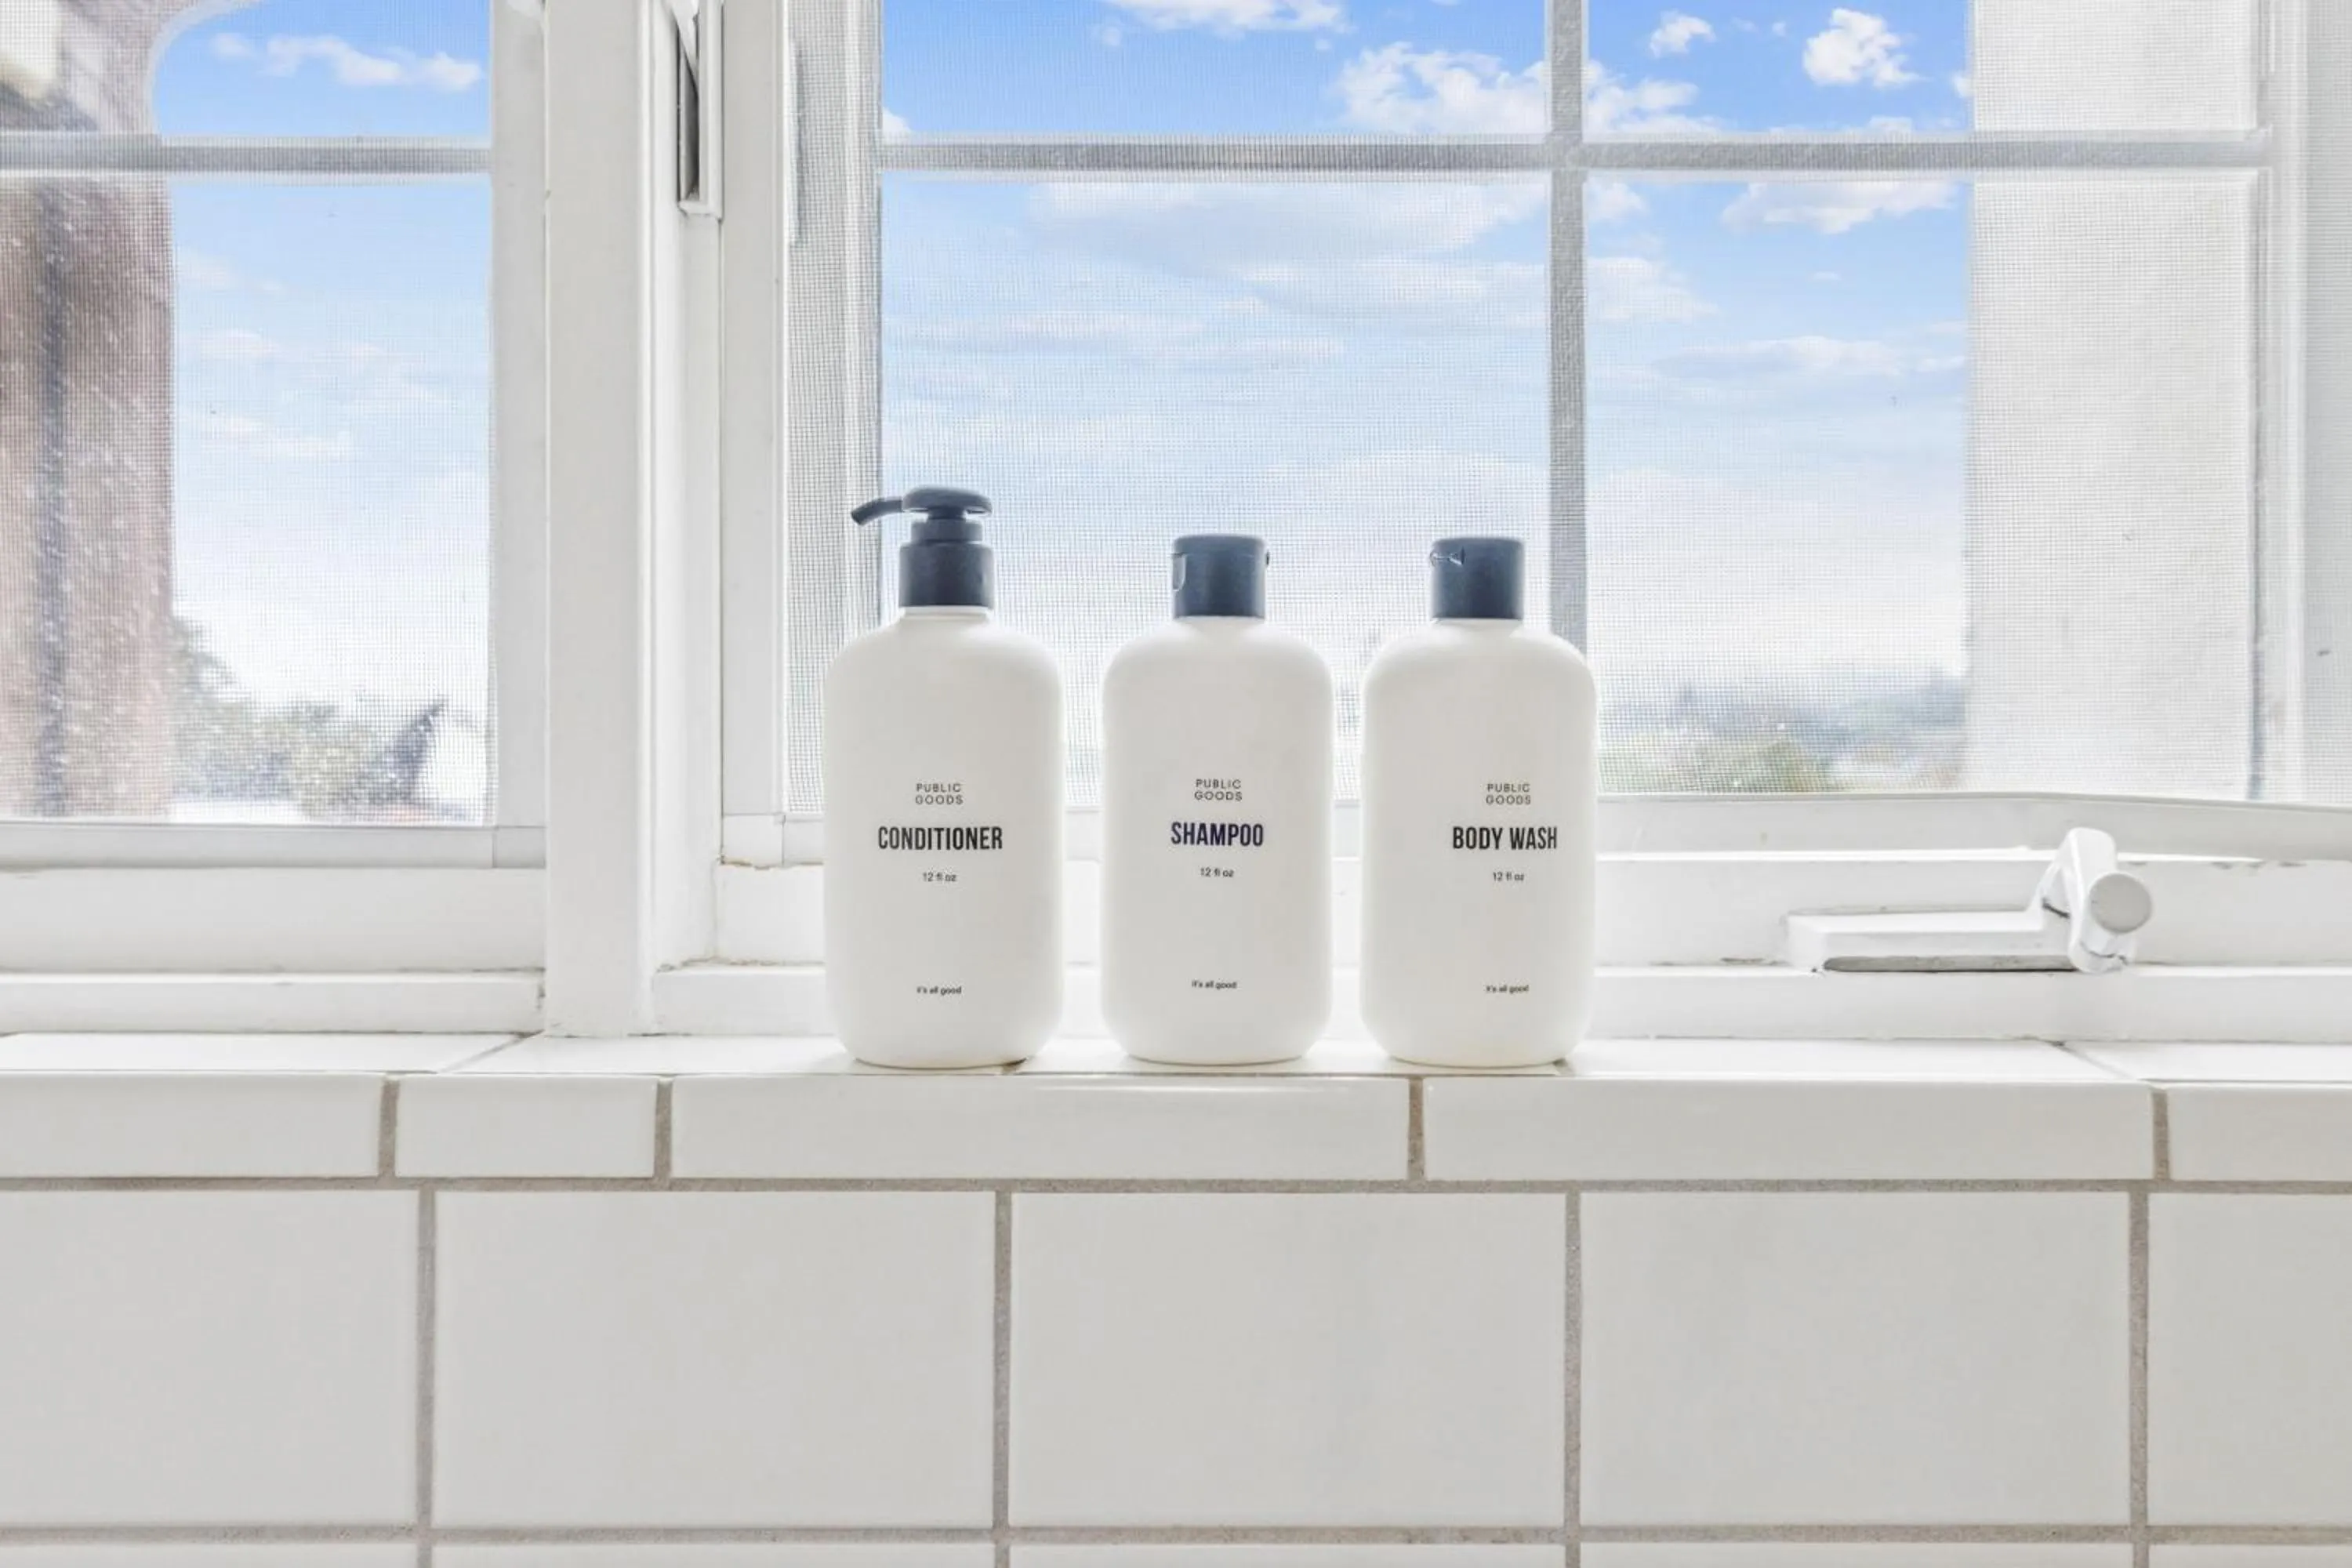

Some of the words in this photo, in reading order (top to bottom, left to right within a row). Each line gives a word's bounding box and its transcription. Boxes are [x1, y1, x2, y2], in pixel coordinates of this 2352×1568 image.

[916, 782, 962, 793] PUBLIC
[1194, 779, 1242, 789] PUBLIC
[1486, 782, 1530, 793] PUBLIC
[915, 793, 964, 805] GOODS
[1194, 790, 1243, 801] GOODS
[1485, 793, 1531, 805] GOODS
[877, 826, 1004, 851] CONDITIONER
[1170, 821, 1265, 848] SHAMPOO
[1452, 826, 1504, 851] BODY
[1508, 826, 1558, 851] WASH
[922, 871, 934, 882] 12
[944, 873, 957, 882] oz
[1200, 866, 1211, 877] 12
[1222, 869, 1235, 878] oz
[1492, 871, 1503, 882] 12
[940, 985, 962, 996] good
[1215, 981, 1238, 990] good
[1508, 985, 1530, 995] good
